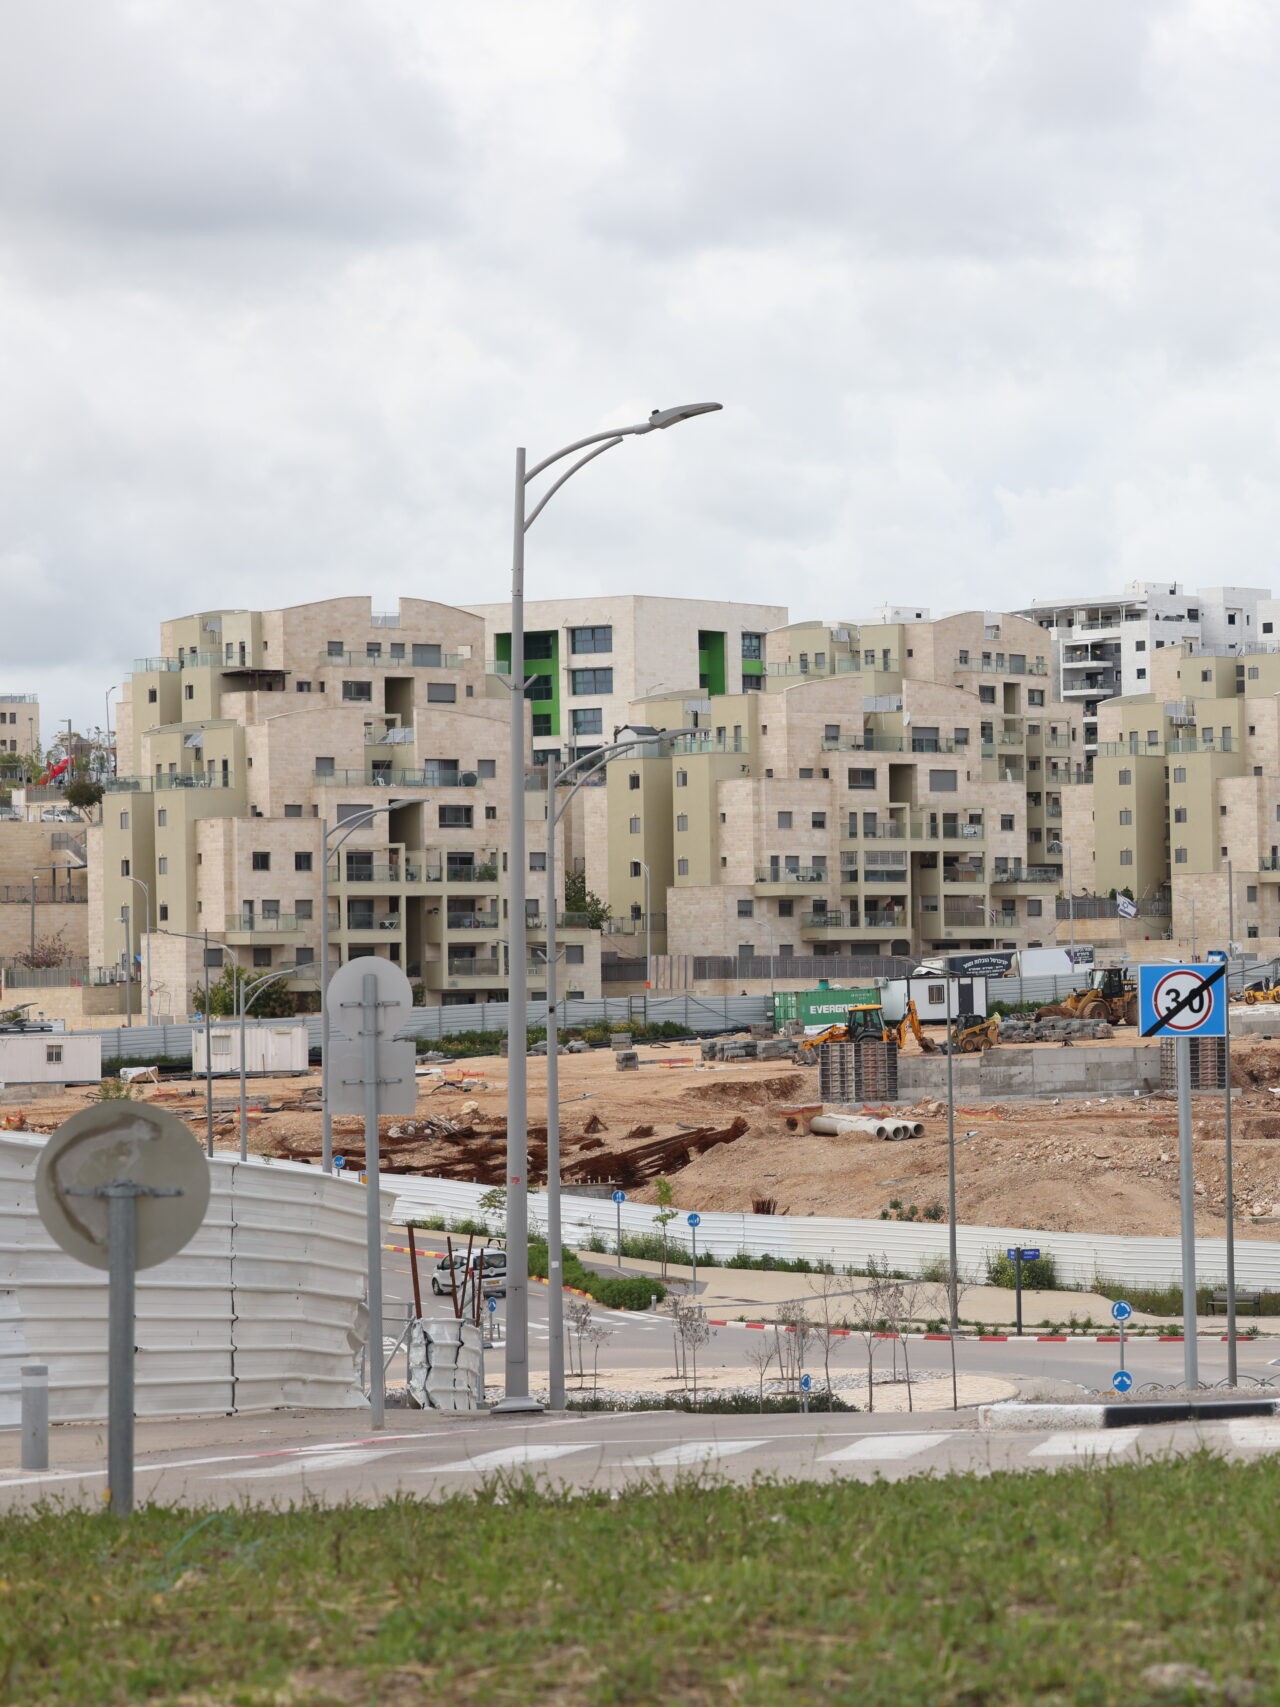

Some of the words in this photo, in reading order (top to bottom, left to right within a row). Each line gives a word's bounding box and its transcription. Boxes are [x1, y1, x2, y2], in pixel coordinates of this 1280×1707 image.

[974, 957, 990, 965] הובלות
[1165, 988, 1204, 1013] 30
[810, 1003, 866, 1014] EVERGR
